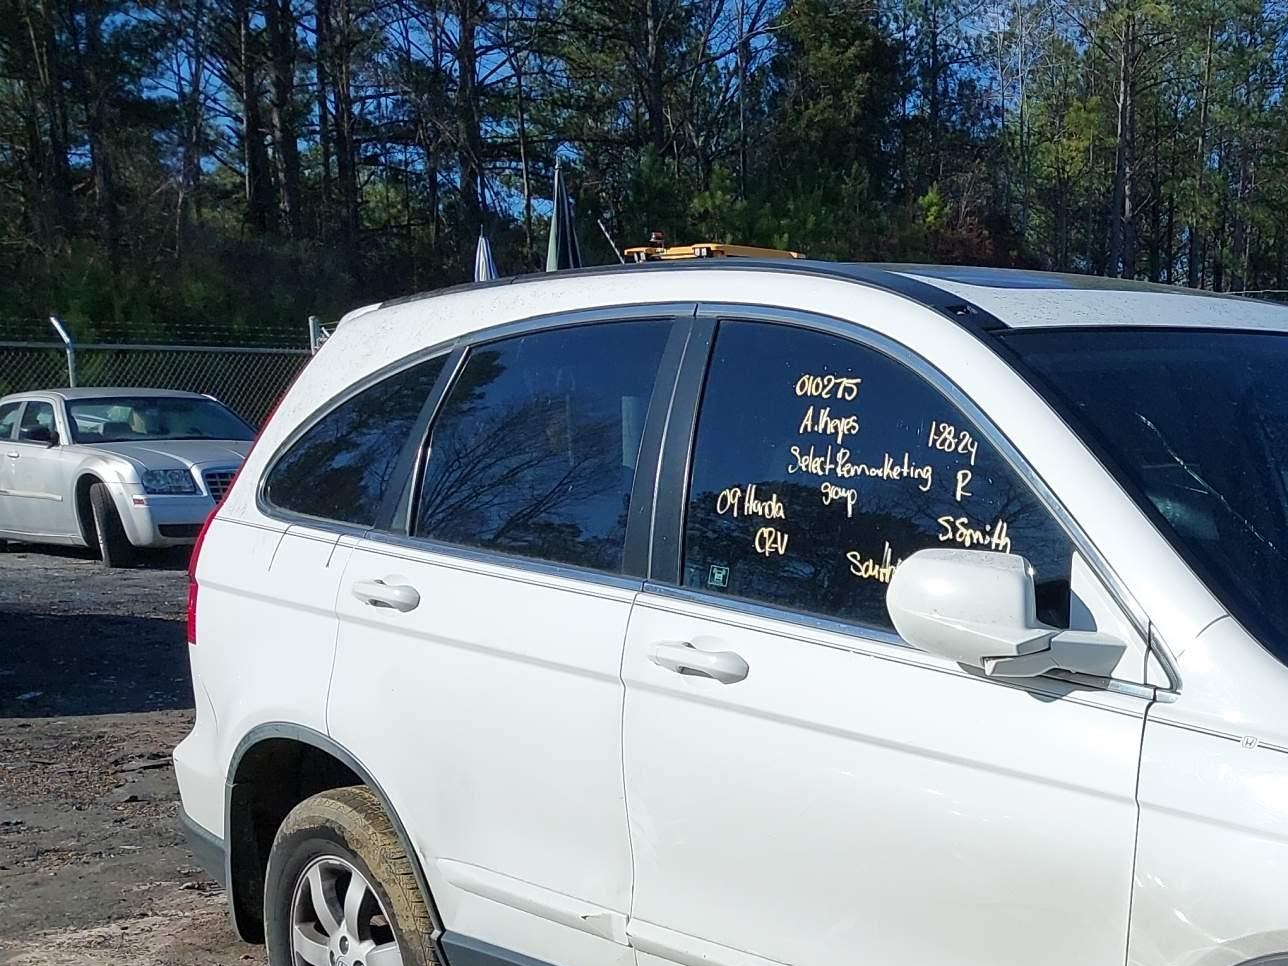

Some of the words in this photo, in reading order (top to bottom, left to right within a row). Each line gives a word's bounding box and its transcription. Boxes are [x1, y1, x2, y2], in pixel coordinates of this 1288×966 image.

[796, 375, 861, 400] 010275
[788, 445, 835, 475] Select
[956, 470, 972, 501] R
[717, 487, 741, 517] 09
[744, 483, 785, 519] Honda
[754, 527, 788, 556] CR-V
